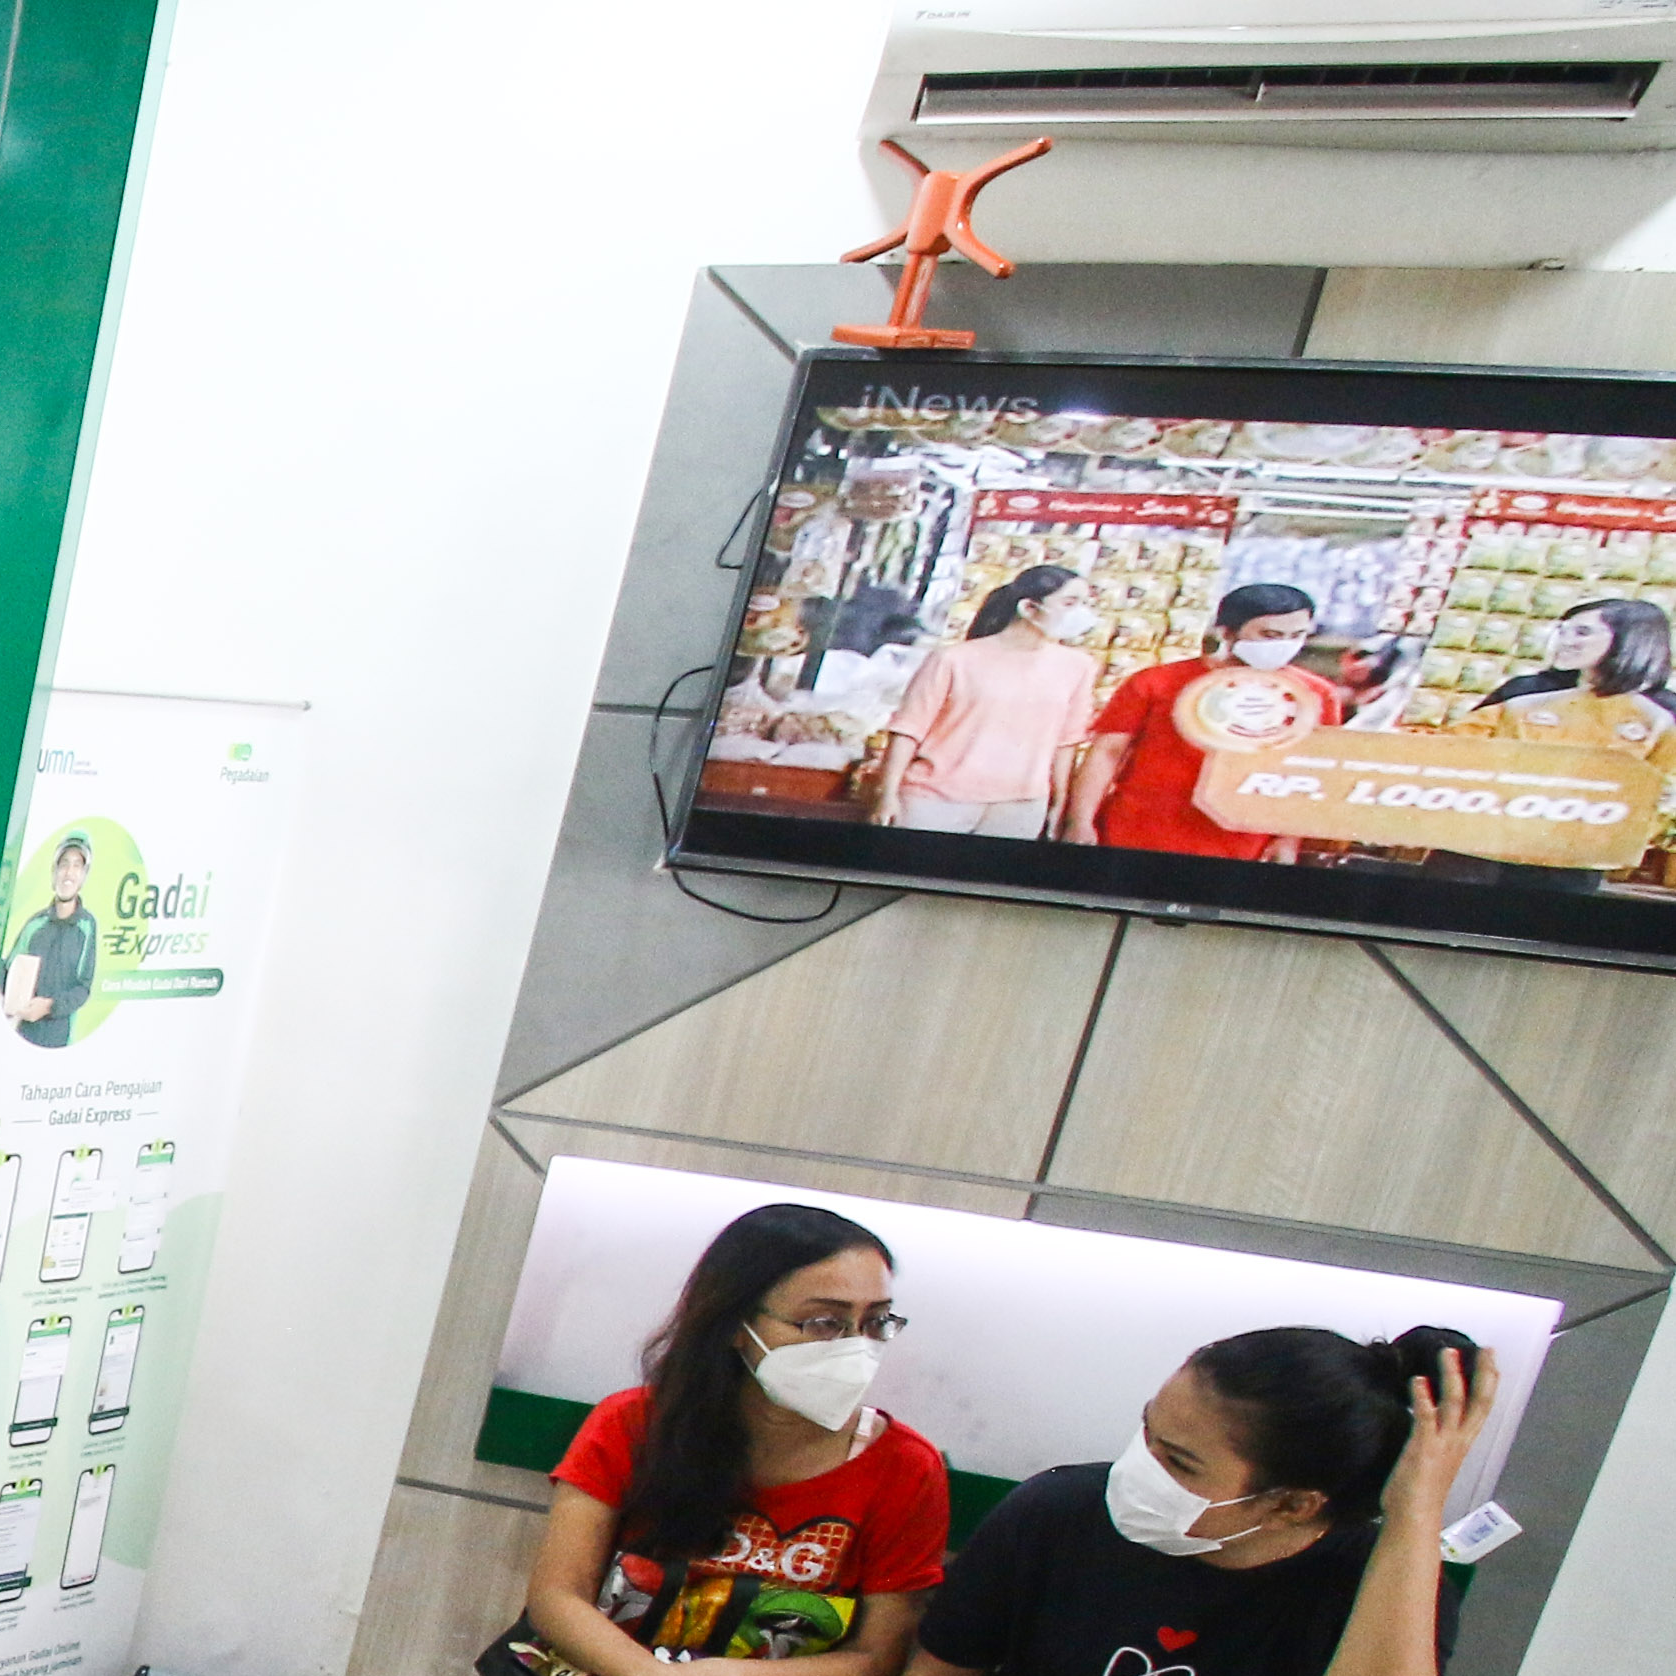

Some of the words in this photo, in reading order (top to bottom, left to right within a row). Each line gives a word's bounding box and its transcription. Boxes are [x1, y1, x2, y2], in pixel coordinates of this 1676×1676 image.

[220, 766, 270, 784] Pegadaian
[115, 871, 212, 919] Gadai
[105, 926, 210, 962] Express
[20, 1083, 71, 1102] Tahapan
[75, 1081, 101, 1098] Cara
[104, 1078, 163, 1100] Pengajuan
[49, 1108, 82, 1126] Gadai
[85, 1106, 132, 1126] Express
